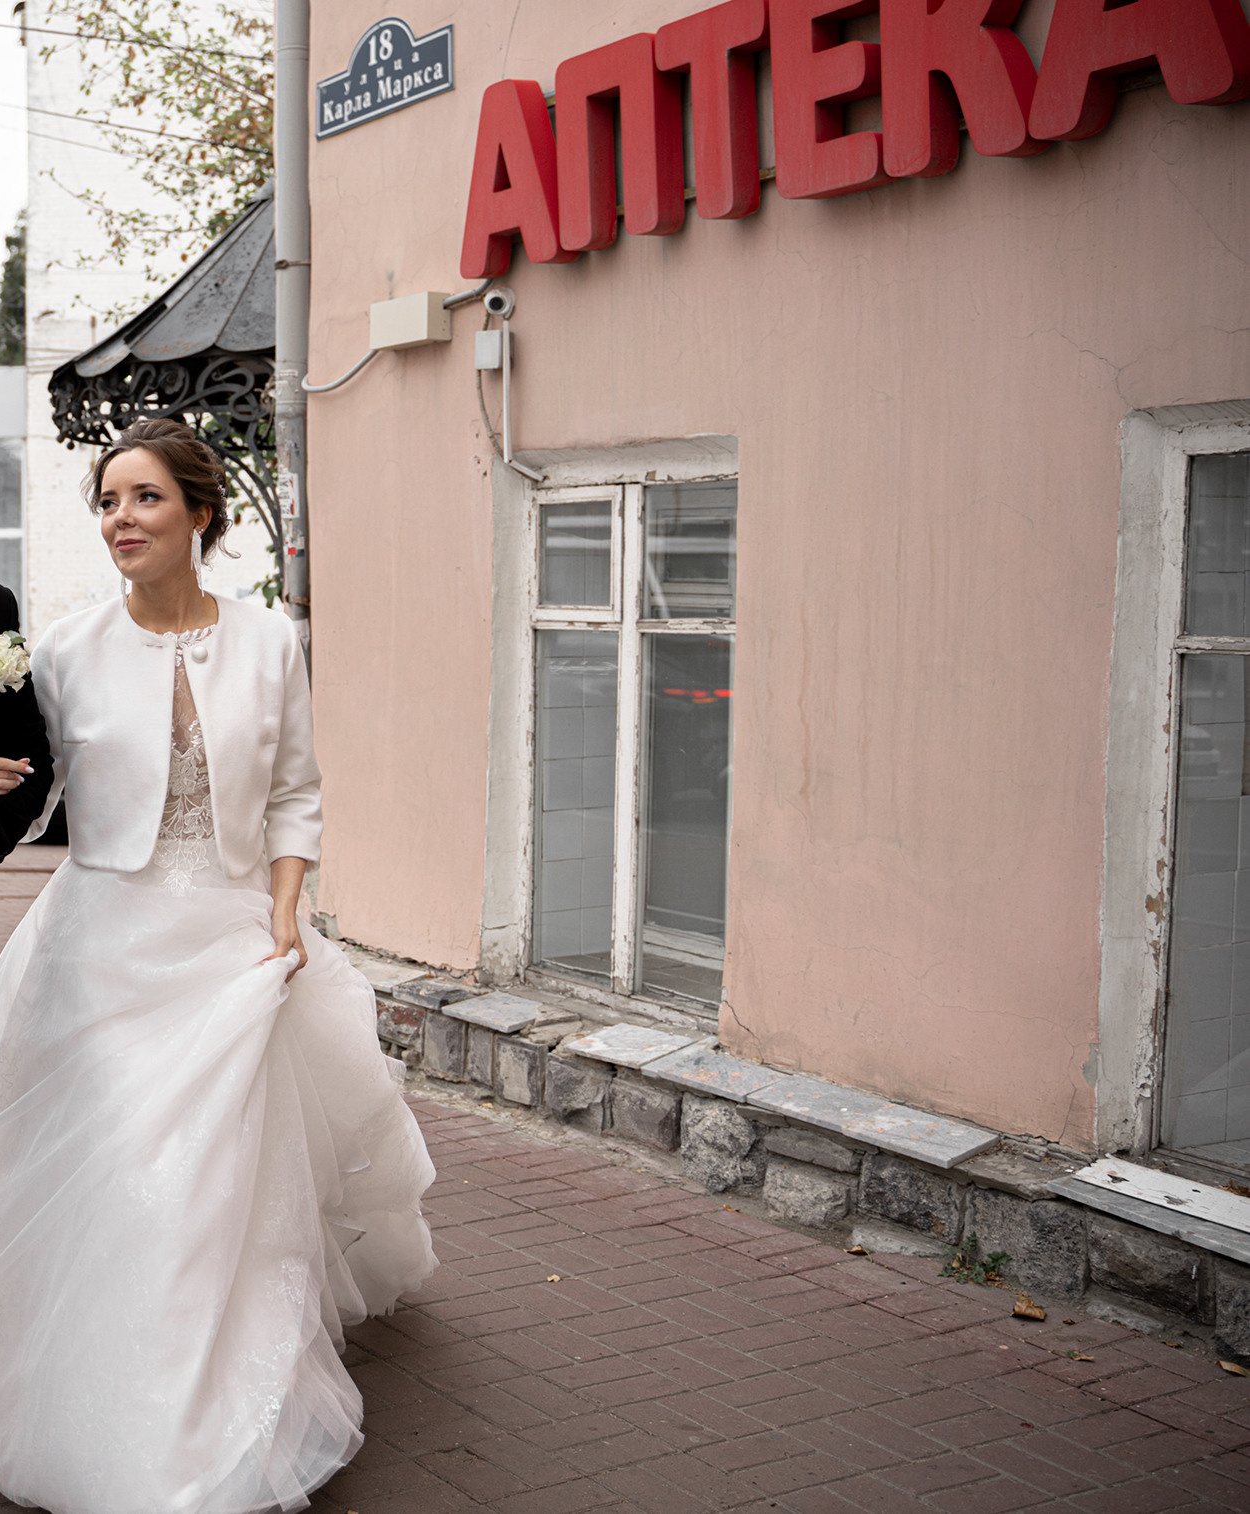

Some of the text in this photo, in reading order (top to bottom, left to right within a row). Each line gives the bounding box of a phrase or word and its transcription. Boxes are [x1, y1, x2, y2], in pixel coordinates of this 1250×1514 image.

[368, 28, 394, 67] 18
[322, 62, 444, 125] Карла Маркса
